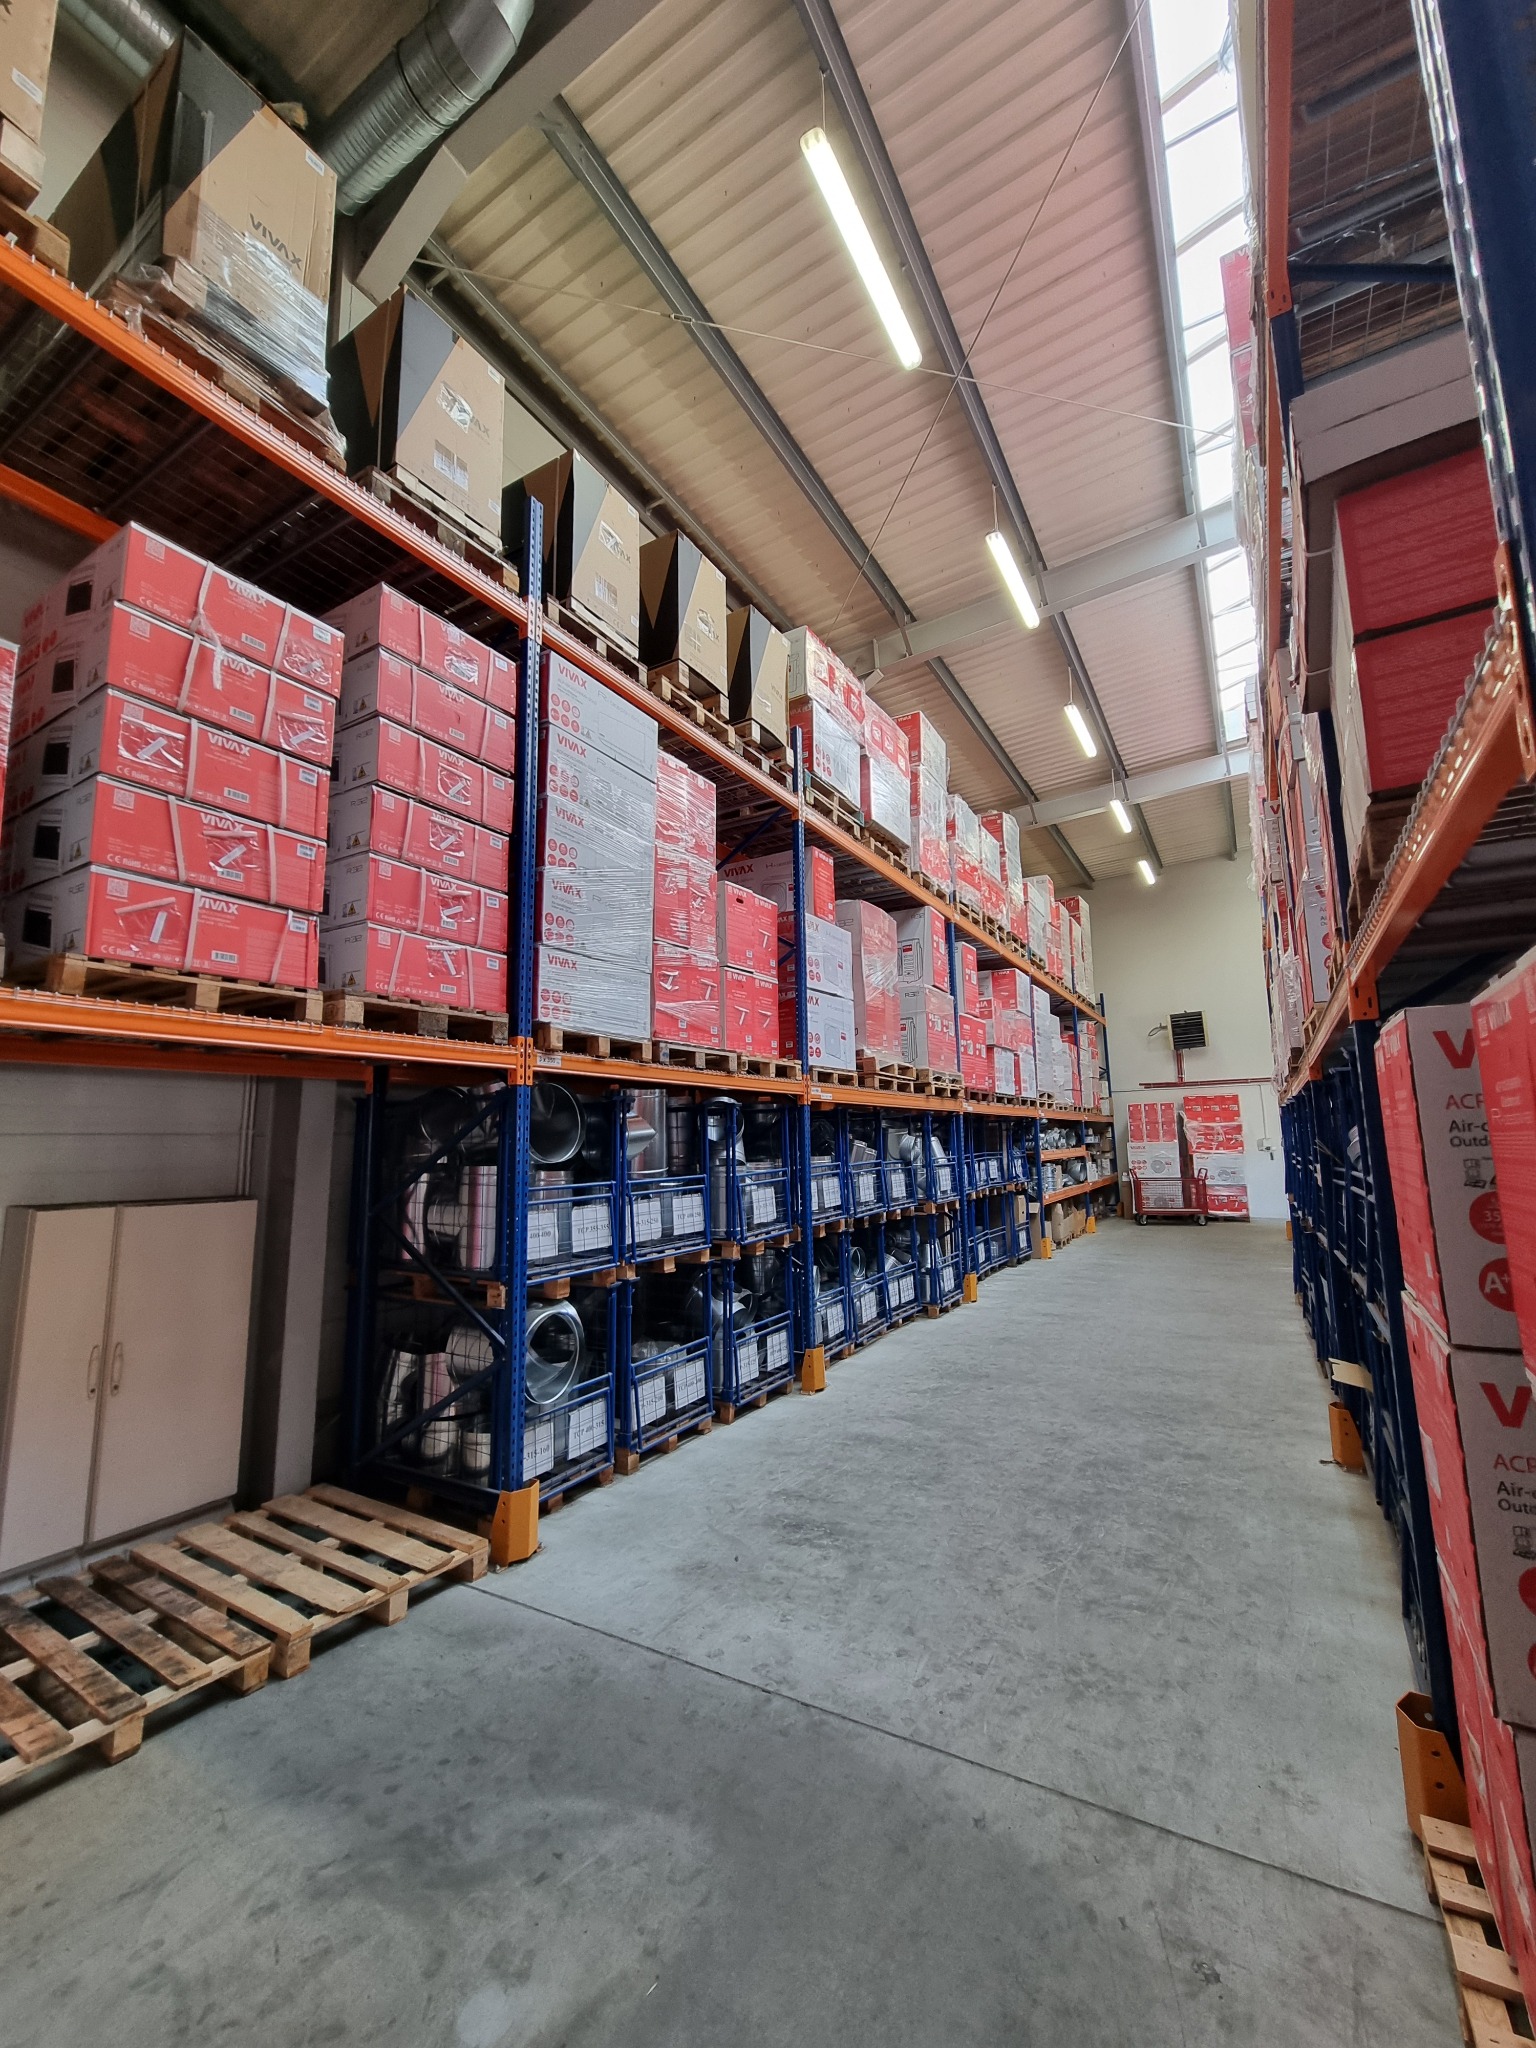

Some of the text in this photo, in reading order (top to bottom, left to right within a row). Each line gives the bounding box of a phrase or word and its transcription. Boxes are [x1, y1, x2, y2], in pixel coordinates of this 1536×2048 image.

[249, 212, 302, 271] VIVAX
[226, 578, 267, 607] VIVAX
[558, 663, 587, 690] VIVAX
[208, 733, 250, 757] VIVAX
[557, 732, 587, 759] VIVAX
[438, 749, 465, 768] VIVAX
[200, 812, 246, 833] VIVAX
[724, 863, 754, 878] VIVAX
[430, 876, 458, 891] VIVAX
[547, 953, 578, 971] VIVAX
